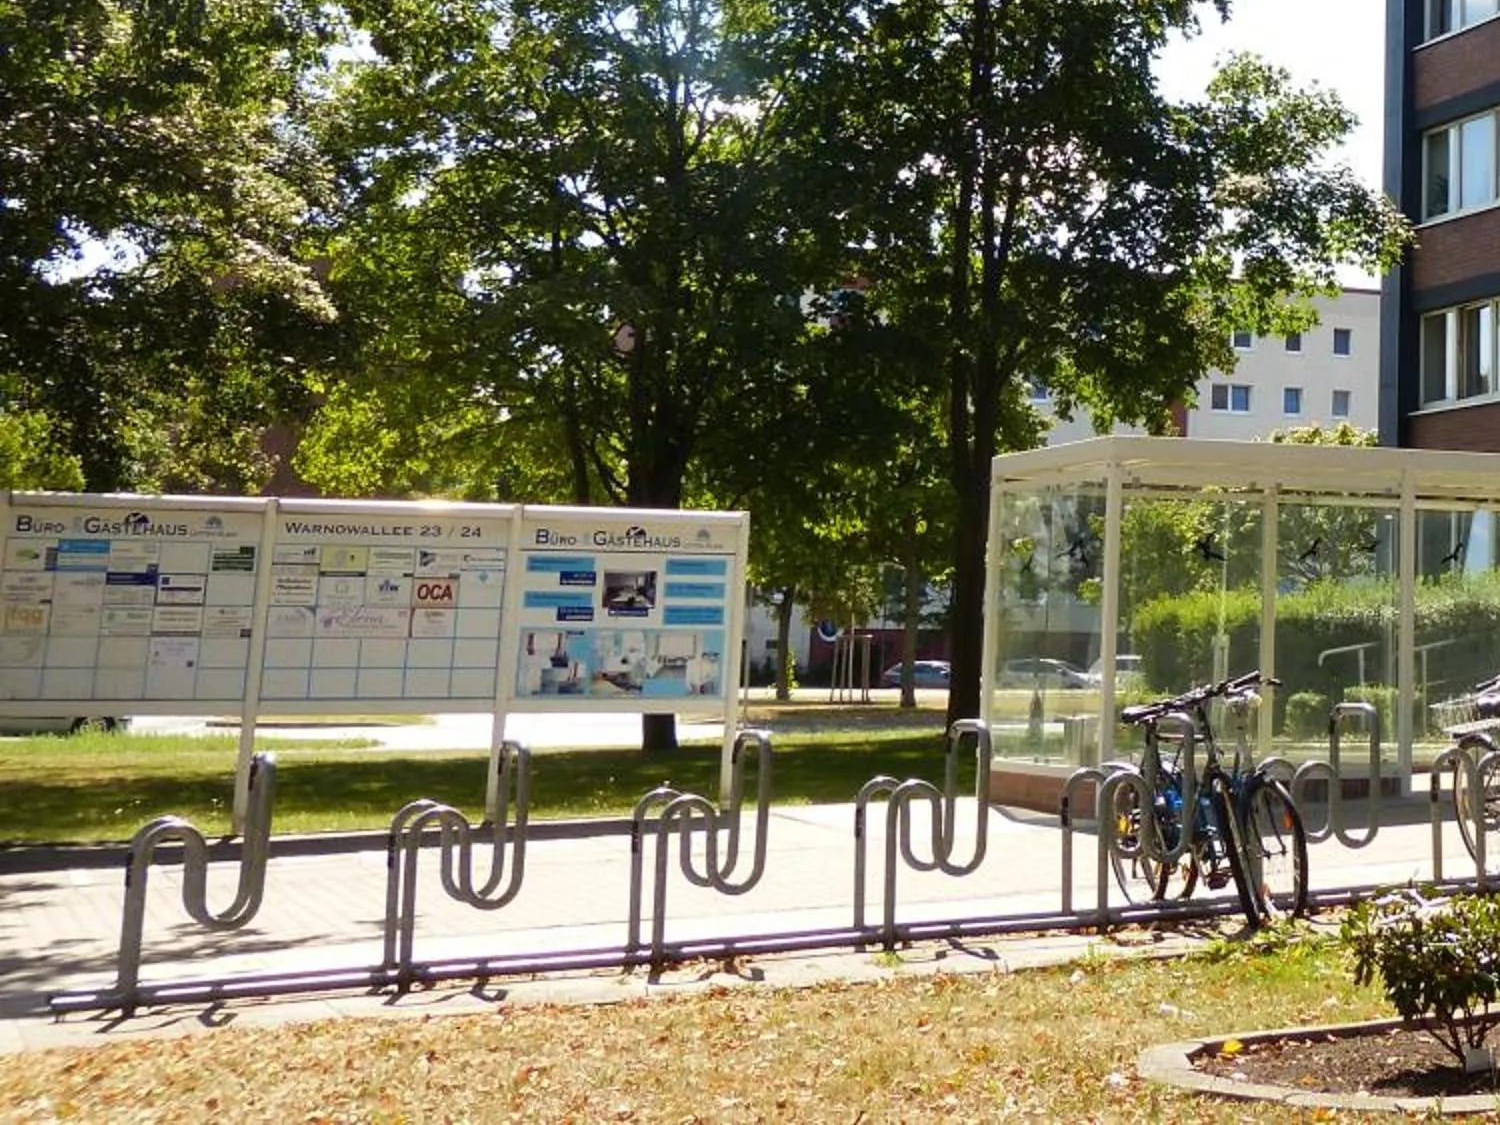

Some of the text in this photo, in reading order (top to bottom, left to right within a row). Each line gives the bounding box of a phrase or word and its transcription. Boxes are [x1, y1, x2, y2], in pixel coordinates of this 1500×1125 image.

[285, 522, 413, 536] WARNOWALLEE
[419, 525, 442, 537] 23
[460, 526, 482, 538] 24
[417, 584, 453, 600] OCA
